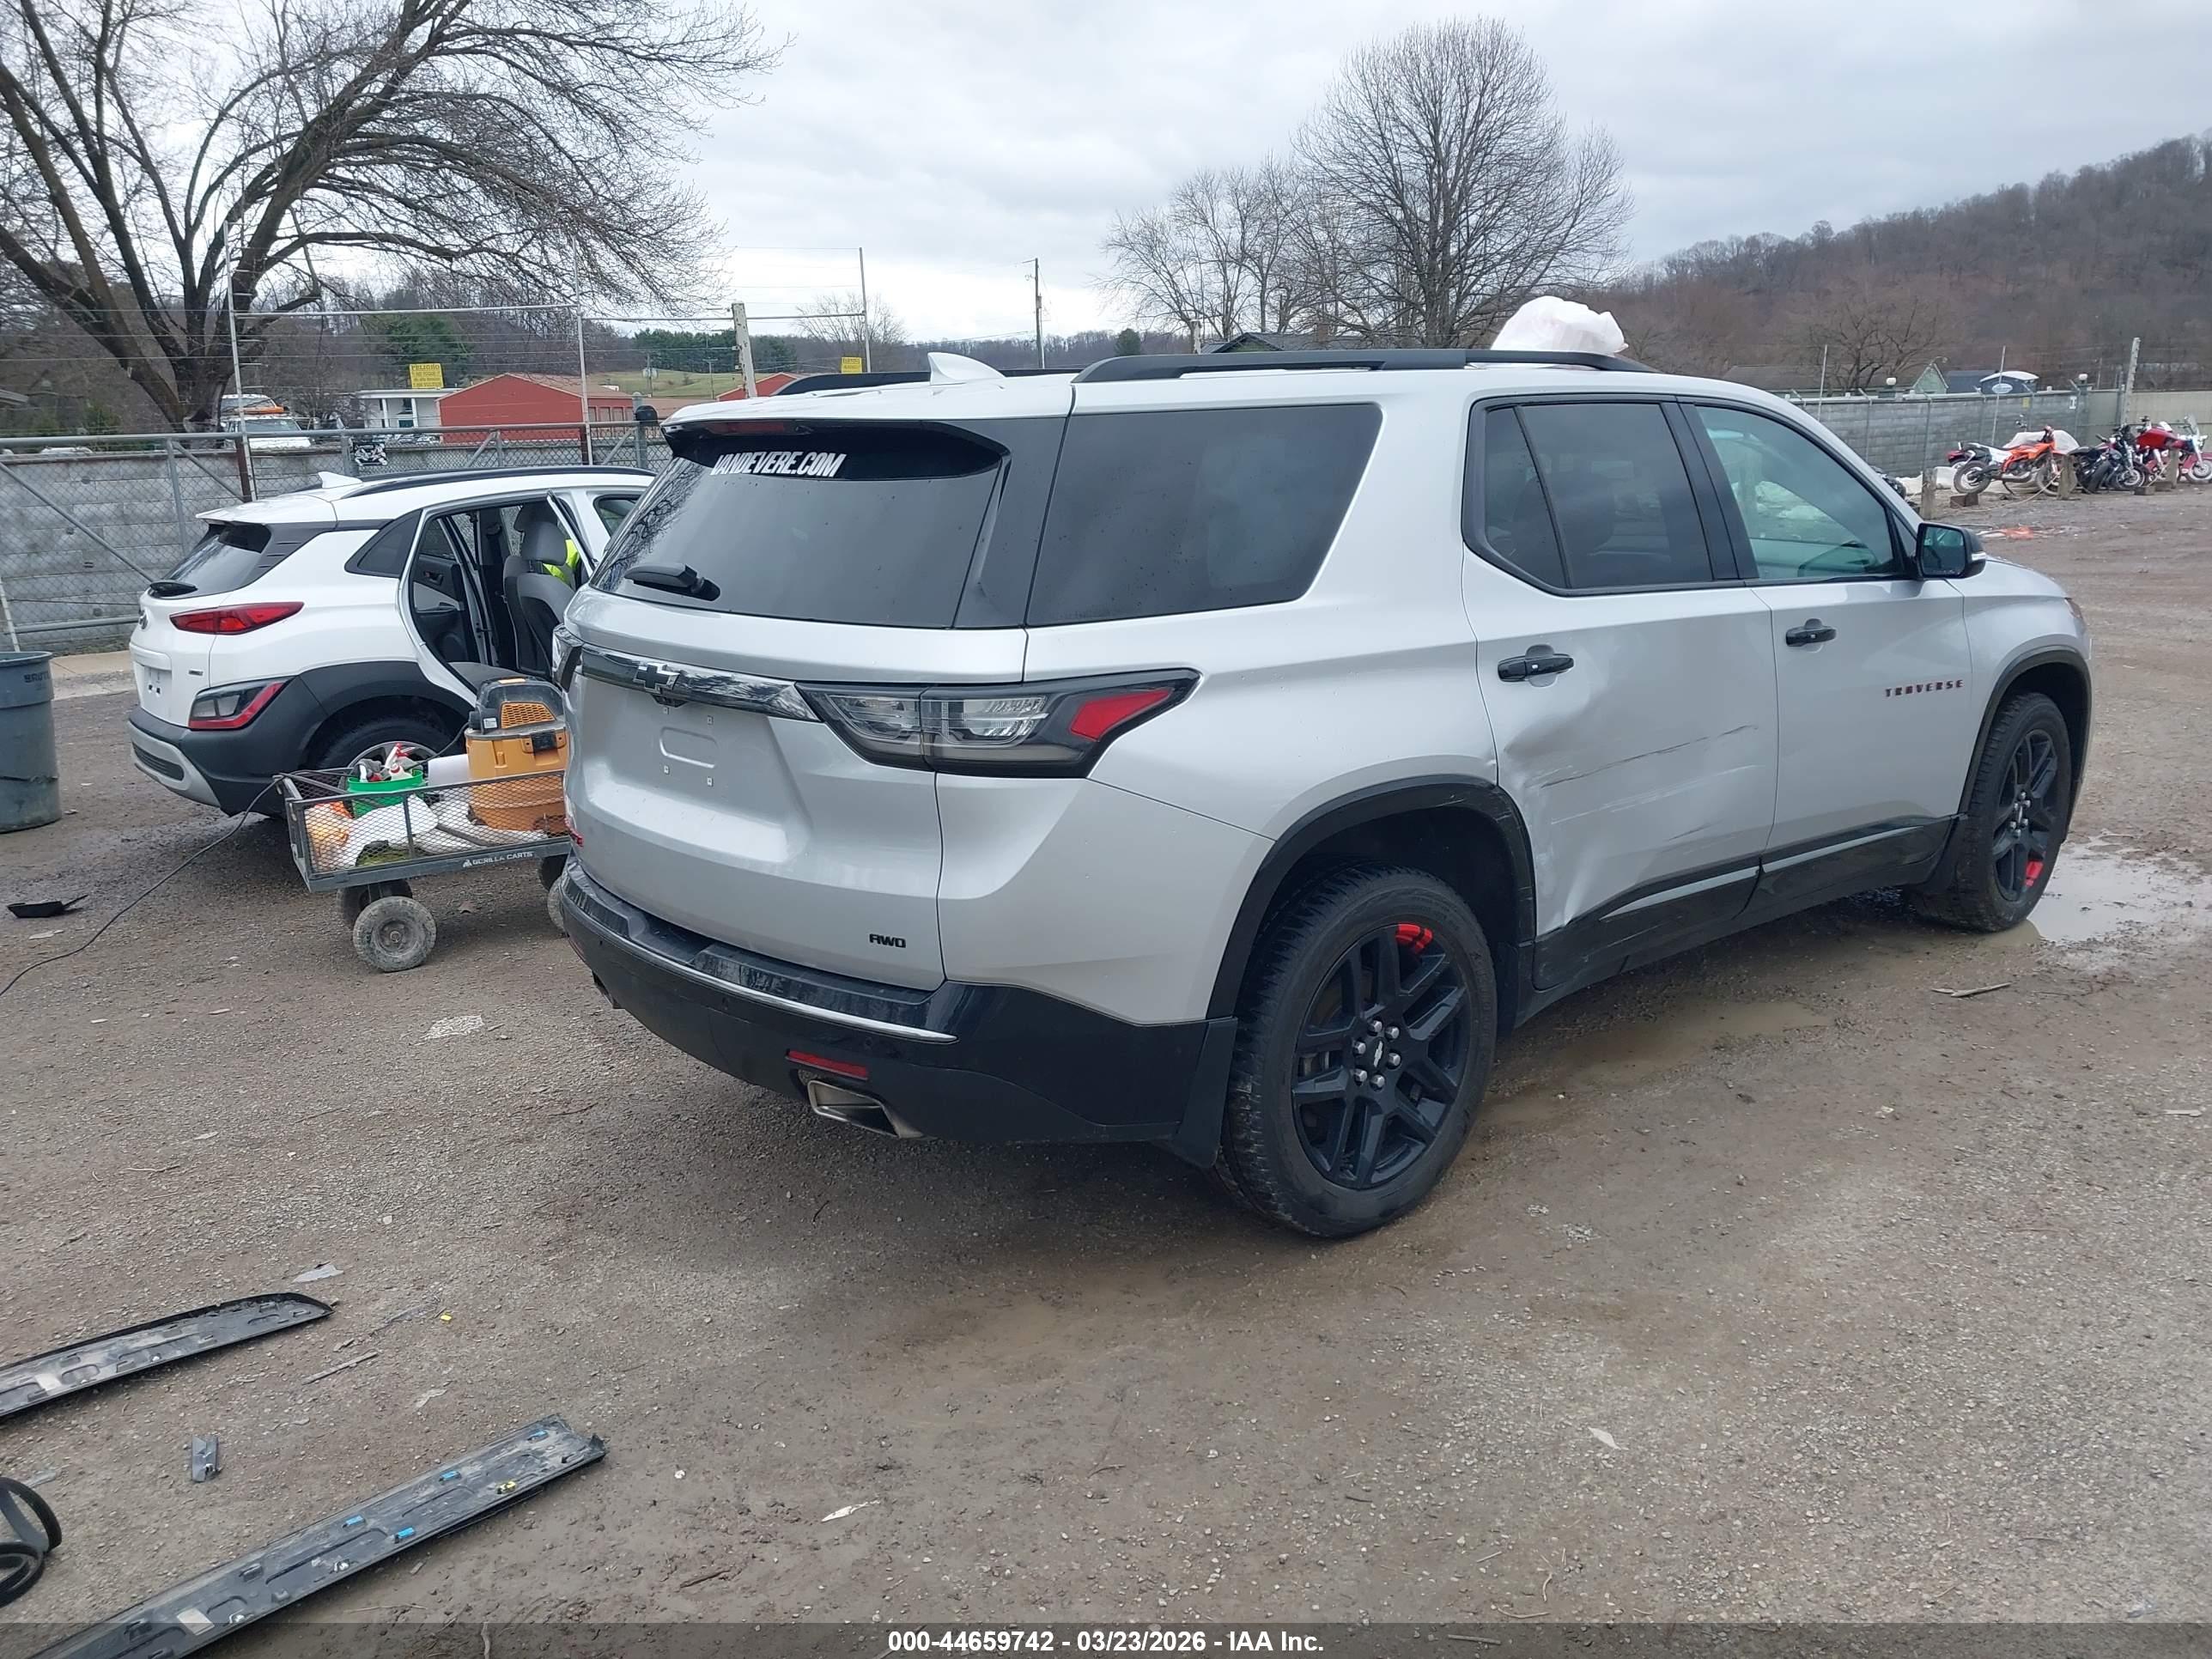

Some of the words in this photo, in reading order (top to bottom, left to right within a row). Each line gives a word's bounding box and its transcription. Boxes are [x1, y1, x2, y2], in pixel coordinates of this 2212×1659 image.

[709, 451, 848, 477] VANDEVERE.COM
[1885, 679, 1964, 697] TRAVERSE
[507, 851, 534, 860] CARTS
[869, 933, 907, 949] AWD
